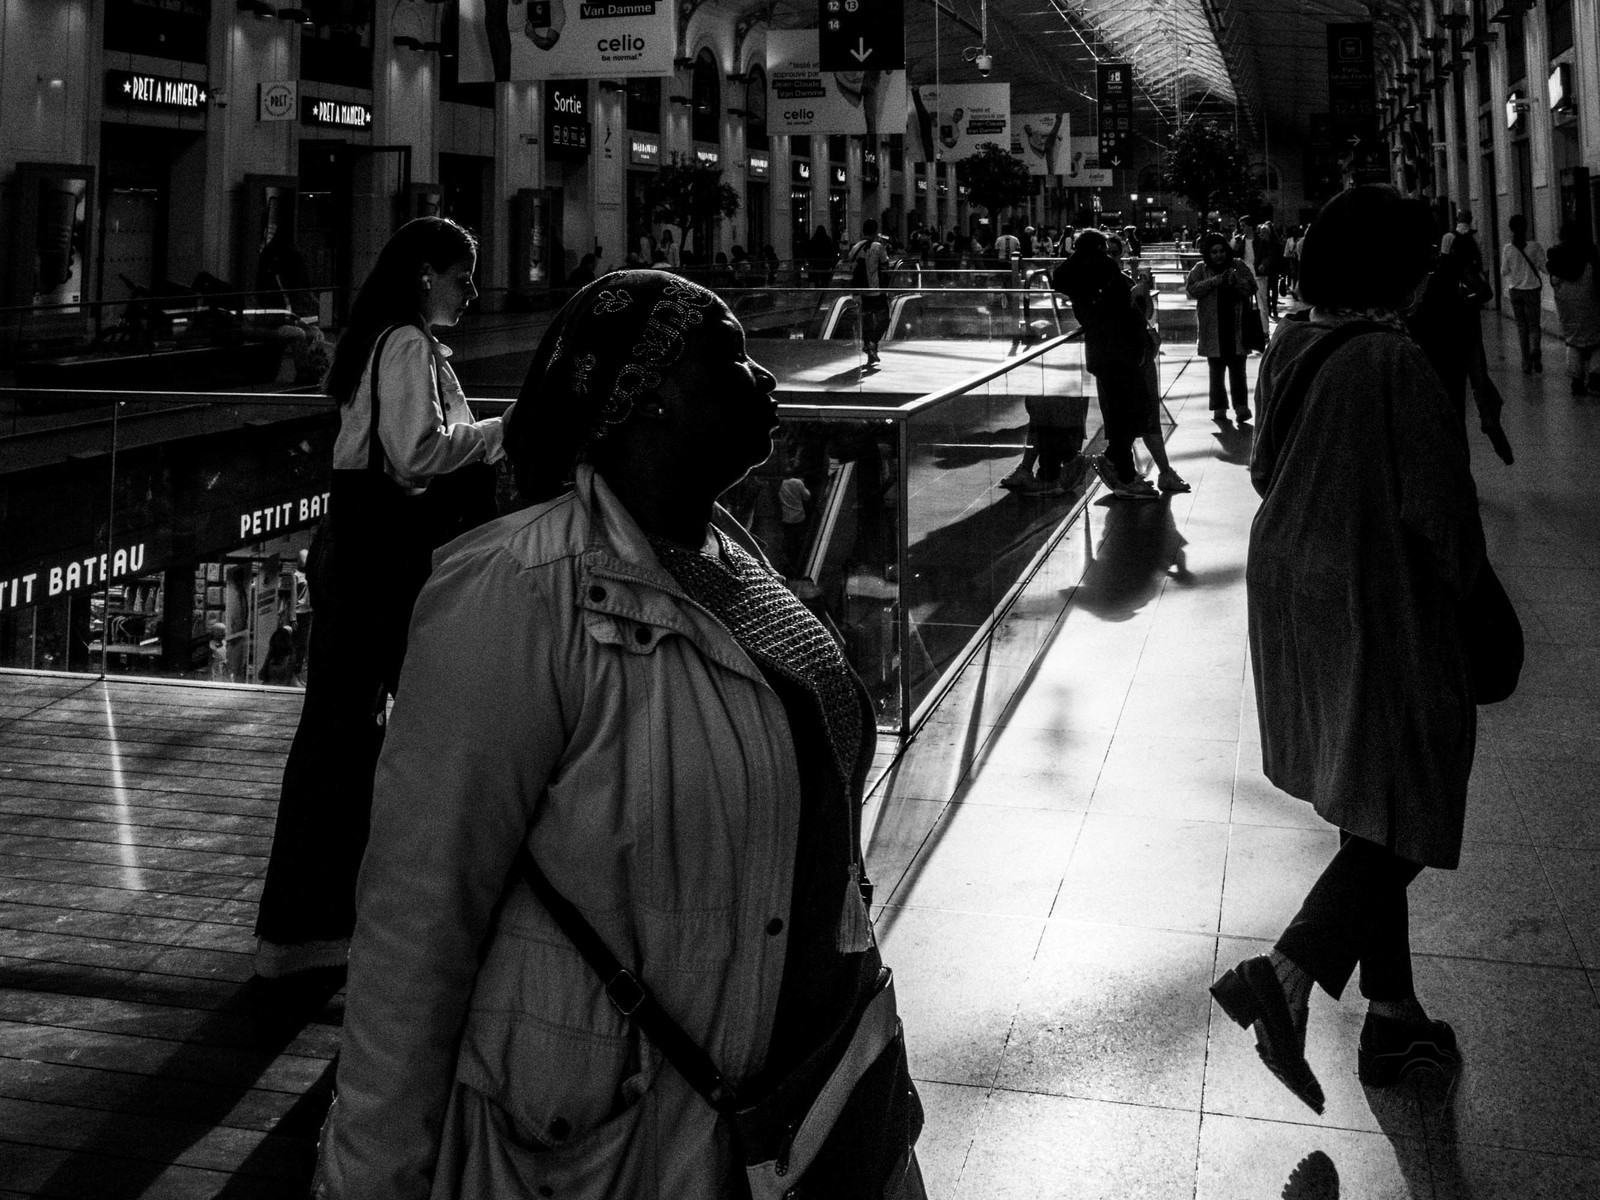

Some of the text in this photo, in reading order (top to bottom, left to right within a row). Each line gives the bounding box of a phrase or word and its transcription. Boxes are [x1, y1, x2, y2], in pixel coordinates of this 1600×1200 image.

[583, 4, 652, 17] Van Damme
[828, 0, 857, 11] 12 13
[828, 20, 840, 30] 14
[597, 34, 645, 52] celio
[773, 70, 819, 79] approuvé par
[133, 76, 198, 107] PRET A MANGER
[779, 89, 824, 98] Van Damme
[270, 94, 287, 107] PRET
[554, 90, 582, 114] Sortie
[318, 101, 335, 122] PRET
[335, 104, 341, 123] A
[341, 105, 366, 126] MANGER
[783, 108, 815, 120] celio
[240, 492, 331, 539] PETIT BAT
[48, 543, 145, 597] BATEAU
